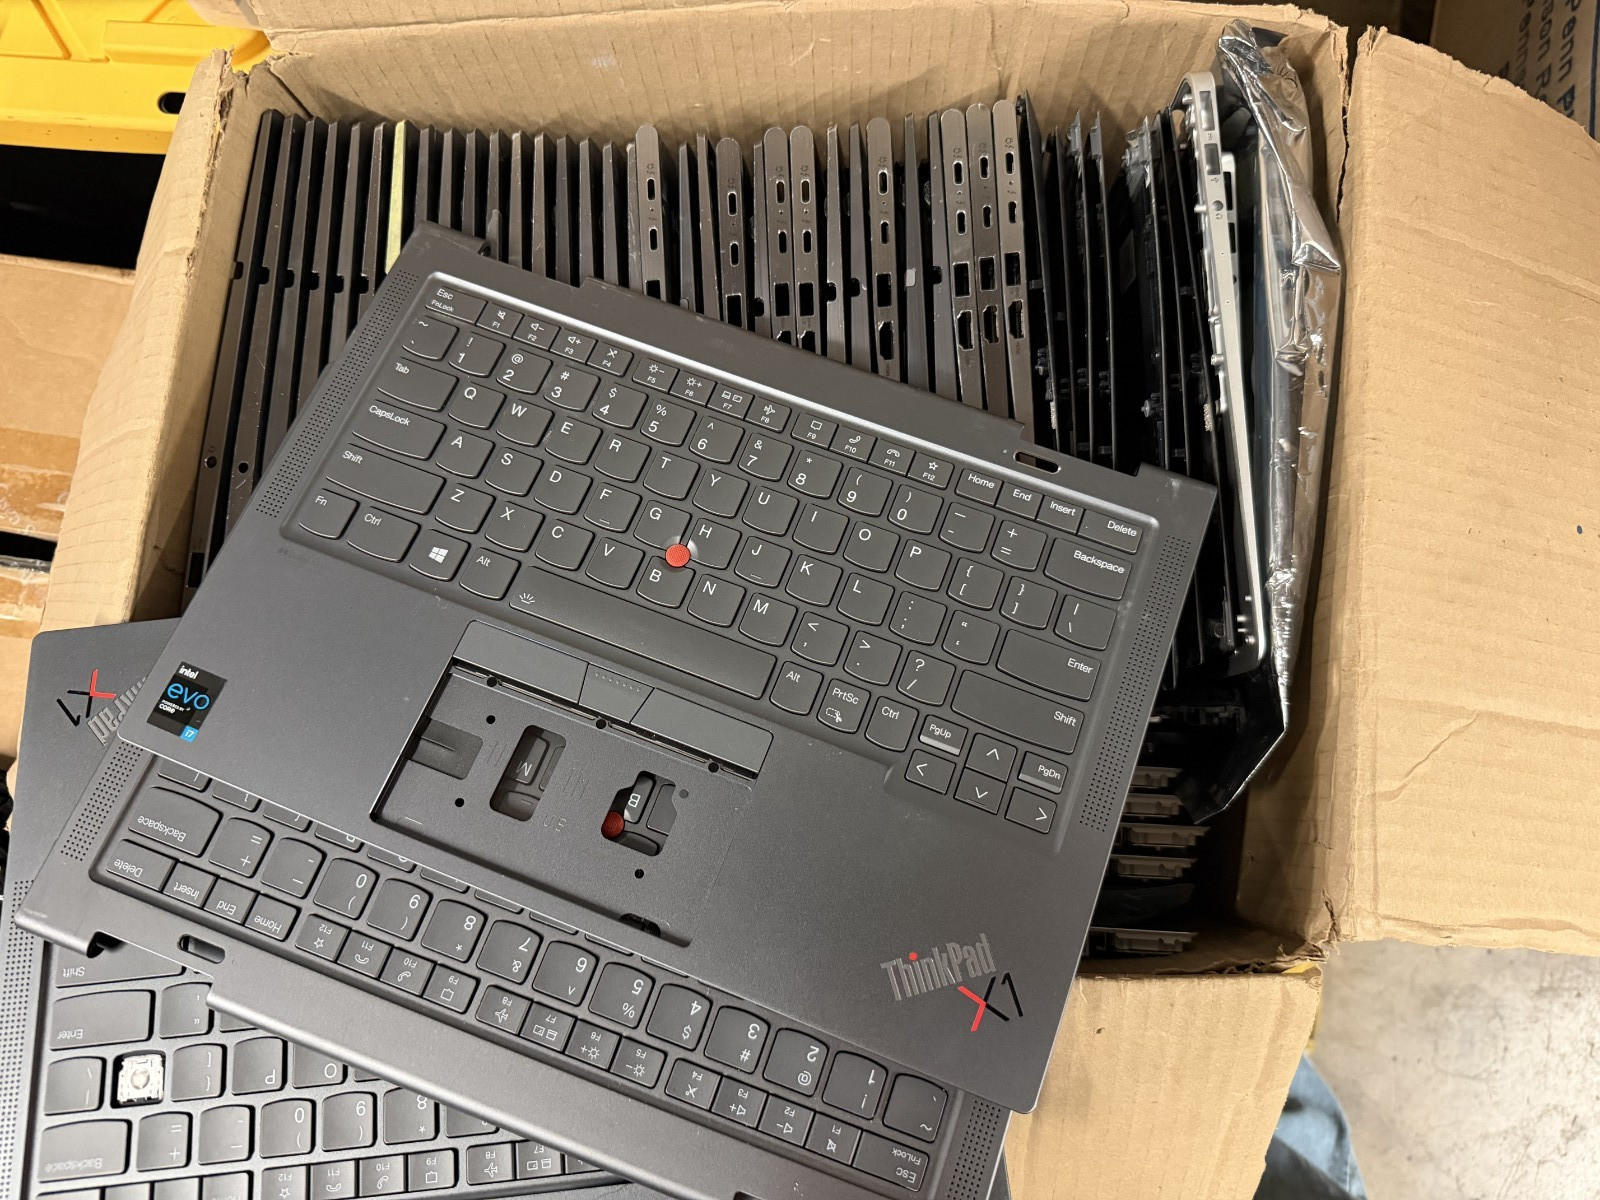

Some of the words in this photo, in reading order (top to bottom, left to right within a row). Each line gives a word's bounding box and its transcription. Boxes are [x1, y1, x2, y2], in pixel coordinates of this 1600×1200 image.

[436, 287, 454, 300] Esc
[431, 300, 455, 312] FnLock
[491, 321, 501, 329] F1
[466, 336, 473, 348] !
[527, 333, 537, 341] F2
[564, 346, 574, 355] F3
[458, 352, 466, 364] 1
[511, 353, 524, 365] @
[602, 360, 612, 368] F4
[395, 362, 410, 374] Tab
[502, 369, 515, 382] 2
[560, 371, 570, 381] #
[464, 387, 477, 400] Q
[551, 386, 563, 398] 3
[608, 387, 617, 399] $
[684, 389, 694, 397] F6
[511, 403, 527, 417] W
[600, 404, 609, 415] 4
[656, 404, 667, 416] %
[722, 402, 732, 411] F7
[369, 405, 411, 426] CapsLock
[760, 415, 770, 424] F8
[561, 422, 573, 434] E
[648, 420, 659, 433] 5
[807, 431, 817, 440] F9
[451, 436, 464, 449] A
[609, 439, 622, 452] R
[697, 438, 708, 450] 6
[754, 440, 763, 450] &
[844, 444, 857, 453] F10
[342, 450, 363, 464] Shift
[501, 453, 513, 466] S
[661, 456, 671, 469] T
[747, 455, 758, 467] 7
[883, 459, 896, 467] F11
[550, 471, 562, 483] D
[710, 474, 721, 487] Y
[795, 473, 807, 485] 8
[856, 474, 863, 486] (
[922, 472, 936, 482] F12
[968, 473, 995, 489] Home
[315, 495, 328, 506] Fn
[450, 489, 465, 502] Z
[600, 489, 612, 500] F
[758, 492, 771, 505] U
[846, 490, 857, 503] 9
[906, 491, 912, 503] )
[1013, 489, 1032, 501] End
[501, 507, 515, 521] X
[650, 508, 662, 521] G
[897, 508, 908, 521] 0
[1050, 501, 1076, 516] Insert
[364, 514, 382, 526] Ctrl
[810, 511, 817, 522] I
[551, 526, 564, 539] C
[699, 525, 713, 539] H
[858, 528, 872, 541] O
[1007, 529, 1018, 538] +
[1107, 520, 1137, 537] Delete
[604, 543, 615, 557] V
[751, 544, 762, 556] J
[909, 546, 922, 558] P
[1000, 546, 1012, 555] =
[476, 556, 492, 567] Alt
[1073, 550, 1125, 574] Backspace
[800, 562, 813, 575] K
[966, 565, 974, 577] {
[649, 569, 661, 582] B
[702, 581, 717, 595] N
[853, 580, 862, 593] L
[1018, 584, 1025, 596] }
[752, 600, 769, 615] M
[916, 659, 925, 672] ?
[1067, 658, 1093, 674] Enter
[178, 665, 199, 680] intel
[786, 670, 800, 683] Alt
[56, 668, 117, 727] X1
[167, 683, 210, 710] evo
[832, 687, 859, 704] PrtSc
[881, 707, 899, 720] Ctrl
[1053, 711, 1076, 727] Shift
[185, 729, 195, 738] i7
[929, 724, 952, 739] PgUp
[1038, 765, 1061, 781] PgDn
[628, 793, 641, 808] B
[137, 815, 186, 842] Backspace
[114, 858, 143, 877] Delete
[240, 855, 251, 867] +
[356, 874, 367, 888] 0
[174, 882, 200, 898] Insert
[216, 900, 237, 915] End
[409, 894, 421, 909] 9
[254, 914, 282, 934] Home
[318, 923, 333, 935] F12
[464, 915, 476, 930] 8
[361, 941, 374, 951] F11
[519, 937, 531, 952] 7
[404, 958, 418, 969] F10
[512, 960, 522, 972] &
[576, 957, 588, 973] 6
[880, 932, 997, 1001] ThinkPad
[63, 966, 85, 977] Shift
[449, 976, 460, 985] F9
[632, 979, 644, 995] 5
[502, 997, 513, 1006] F8
[690, 1000, 702, 1015] 4
[957, 972, 1024, 1032] X1
[622, 1003, 635, 1018] %
[546, 1014, 557, 1023] F7
[57, 1028, 83, 1039] Enter
[591, 1031, 602, 1041] F6
[682, 1025, 692, 1040] $
[747, 1023, 760, 1039] 3
[636, 1049, 647, 1059] F5
[739, 1049, 751, 1062] #
[806, 1045, 819, 1062] 2
[265, 1069, 276, 1084] P
[324, 1063, 337, 1078] O
[692, 1071, 703, 1081] F4
[868, 1069, 875, 1085] 1
[797, 1071, 812, 1086] @
[738, 1088, 749, 1099] F3
[416, 1095, 427, 1110] 8
[861, 1094, 867, 1109] !
[294, 1107, 305, 1123] 0
[356, 1101, 366, 1116] 9
[784, 1106, 796, 1117] F2
[831, 1125, 842, 1135] F1
[426, 1157, 437, 1166] F9
[485, 1151, 496, 1159] F8
[891, 1147, 921, 1165] FnLock
[327, 1168, 340, 1177] F11
[376, 1163, 390, 1171] F10
[278, 1173, 292, 1182] F12
[896, 1167, 917, 1183] Esc
